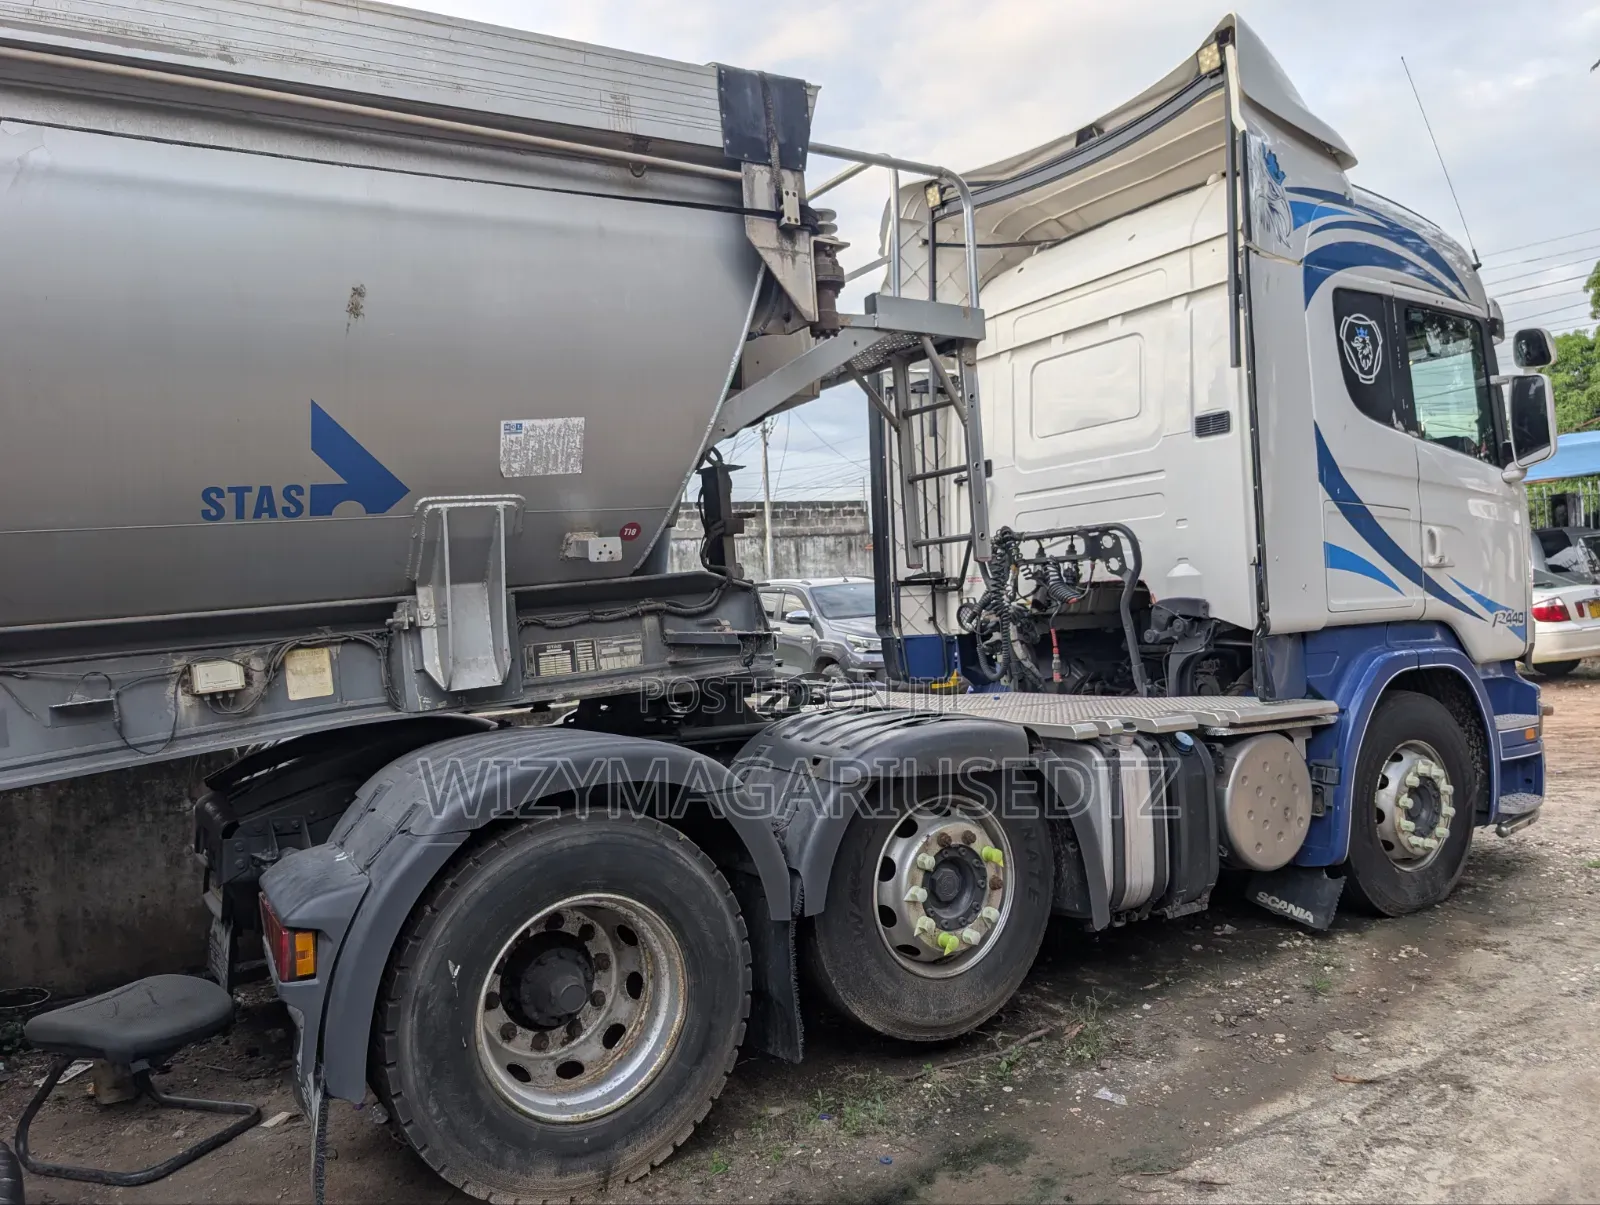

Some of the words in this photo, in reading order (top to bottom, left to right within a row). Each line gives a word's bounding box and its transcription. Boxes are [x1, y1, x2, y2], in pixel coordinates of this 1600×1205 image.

[200, 484, 305, 522] STAS
[1492, 611, 1524, 628] R440
[1256, 891, 1315, 924] SCANIA
